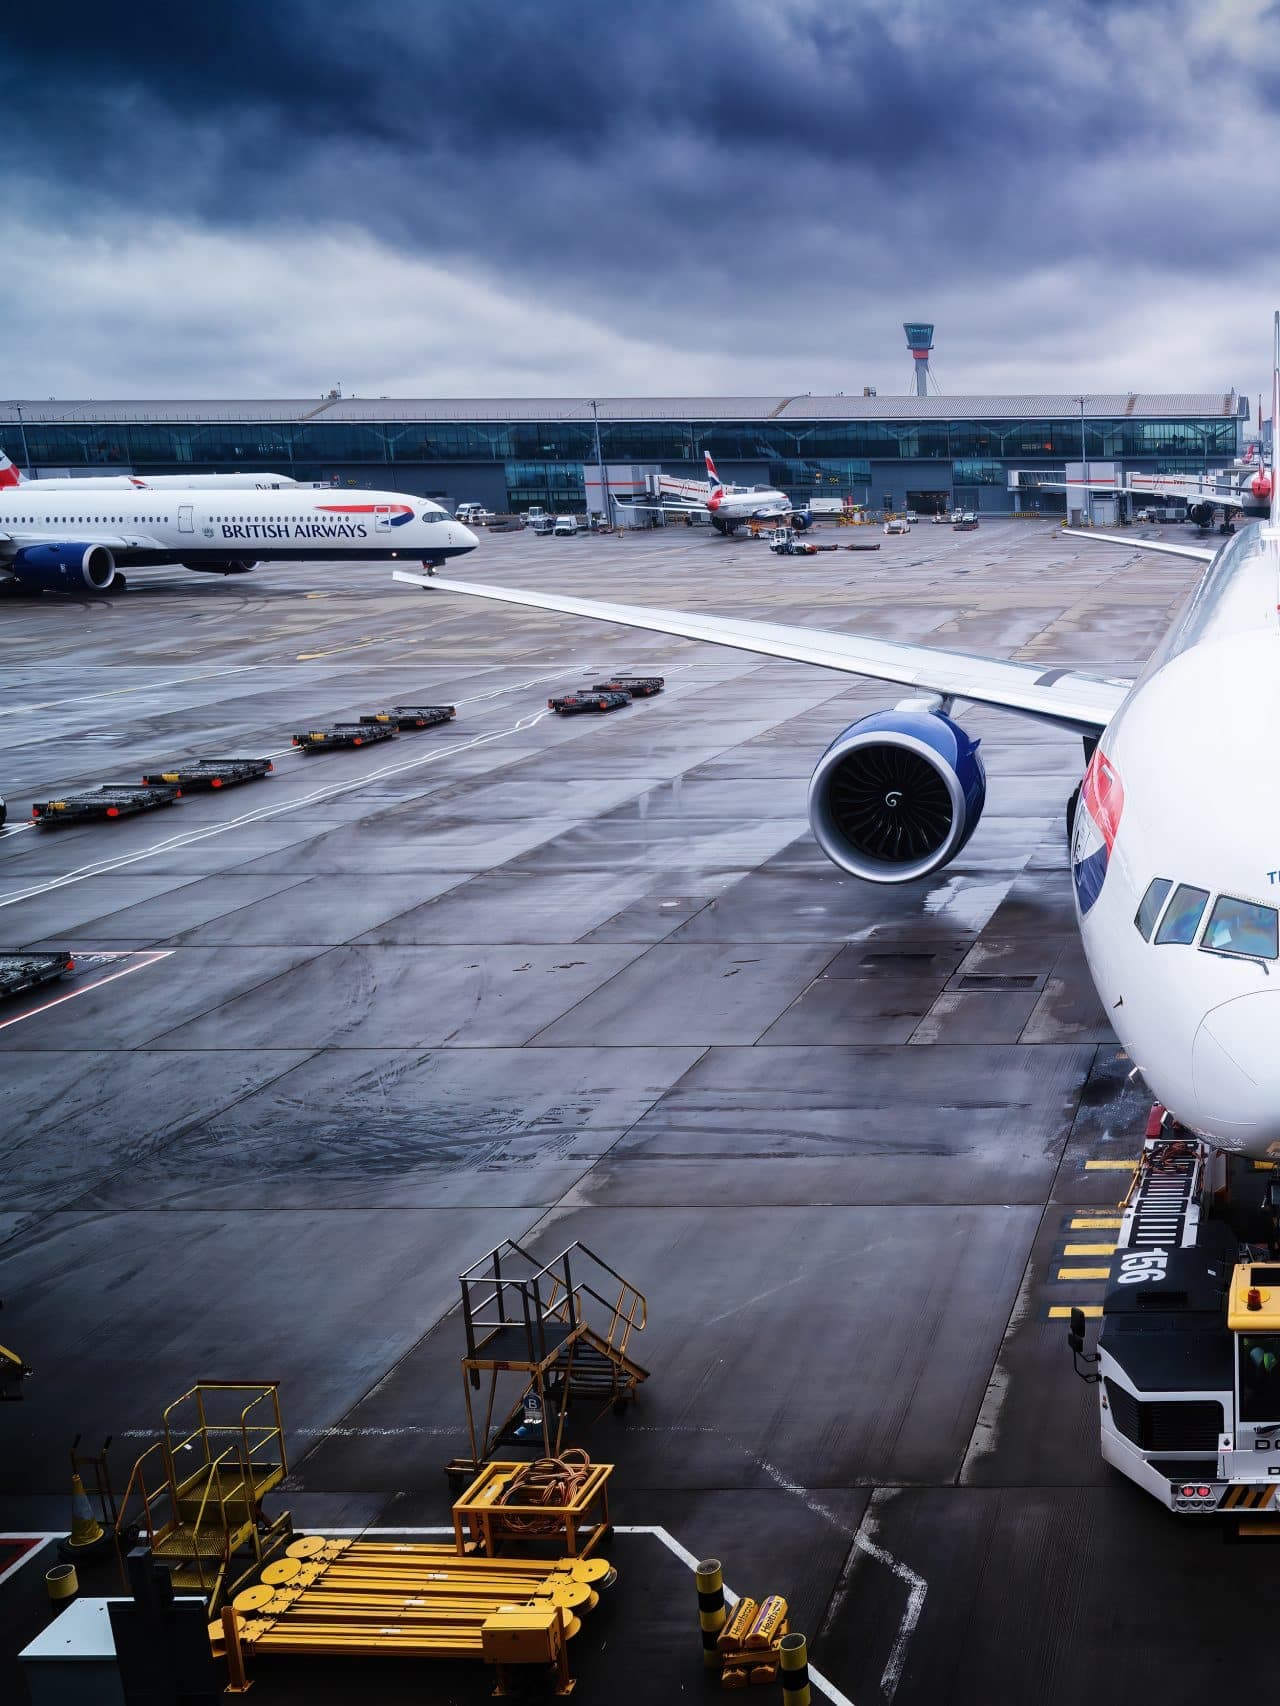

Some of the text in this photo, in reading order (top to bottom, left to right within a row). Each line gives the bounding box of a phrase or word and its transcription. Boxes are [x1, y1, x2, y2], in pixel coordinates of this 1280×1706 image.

[222, 524, 368, 538] BRITISH AIRWAYS
[1117, 1247, 1168, 1284] 156
